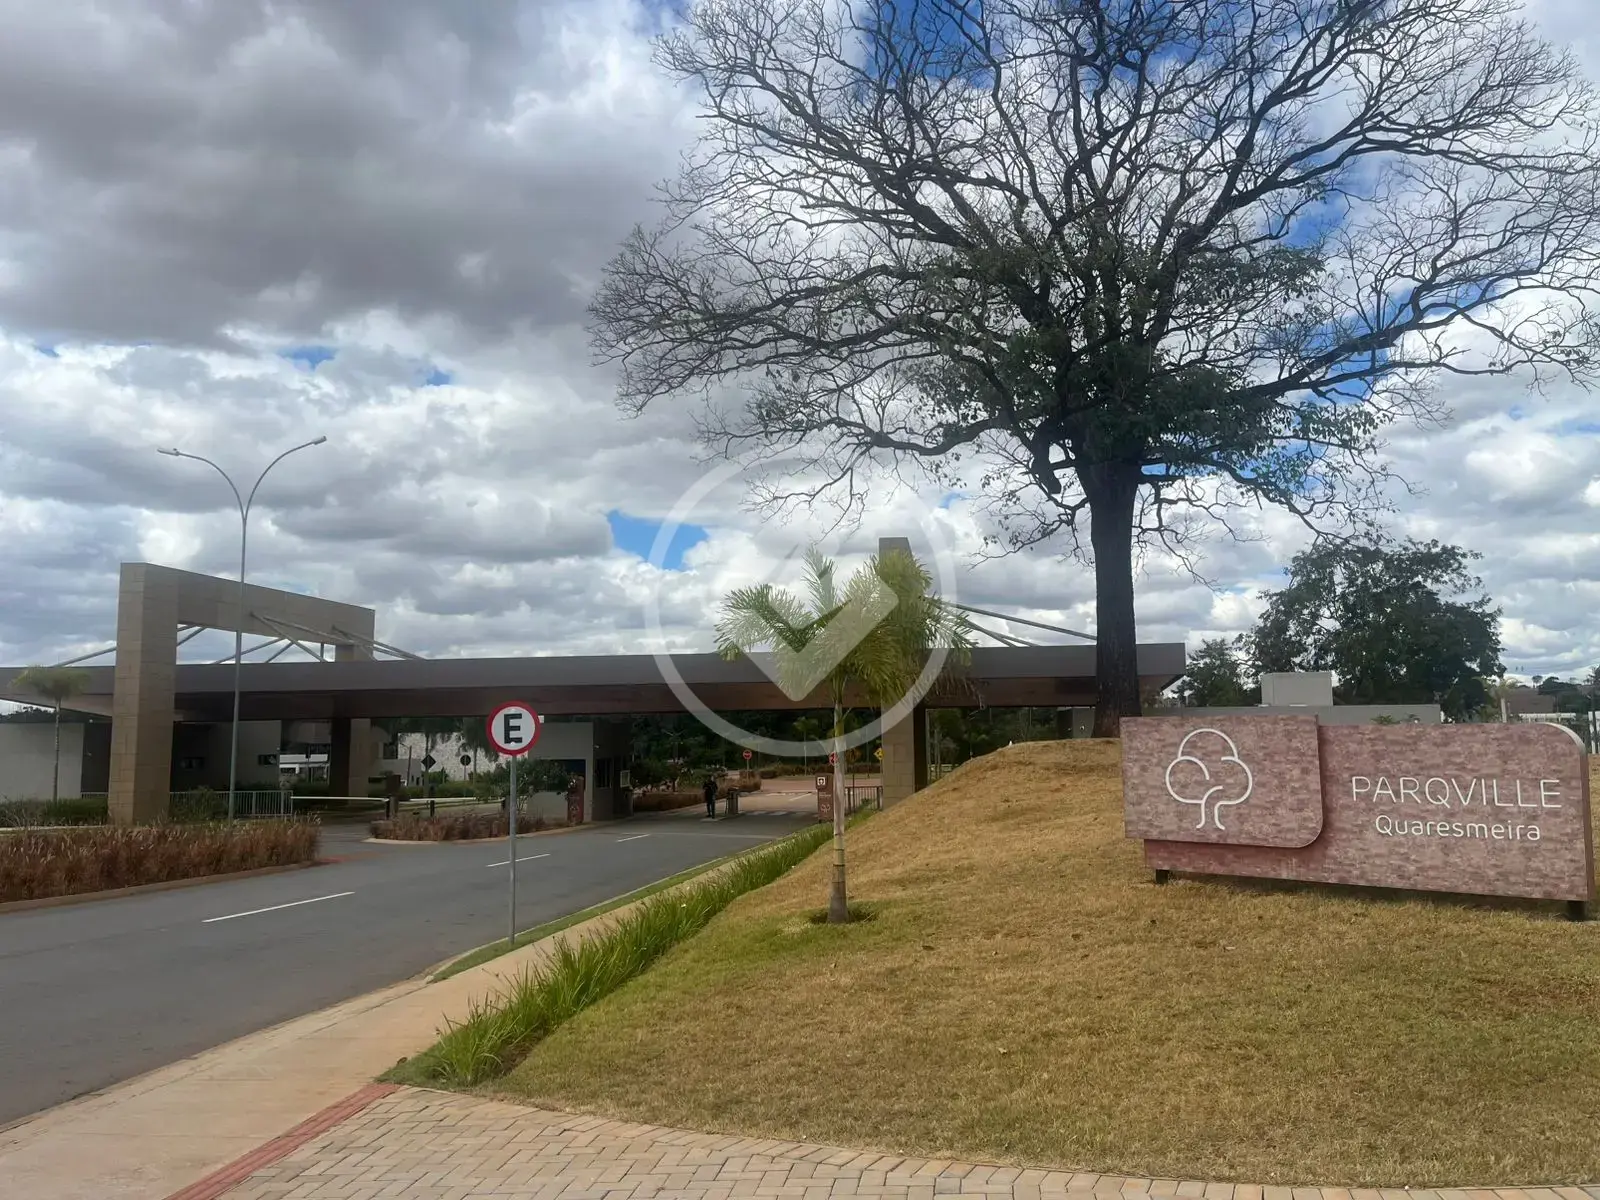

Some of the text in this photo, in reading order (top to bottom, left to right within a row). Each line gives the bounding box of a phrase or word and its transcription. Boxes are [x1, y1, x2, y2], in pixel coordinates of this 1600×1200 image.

[504, 713, 522, 744] E
[1352, 776, 1562, 808] PARQVILLE
[1375, 815, 1540, 841] Quaresmeira
